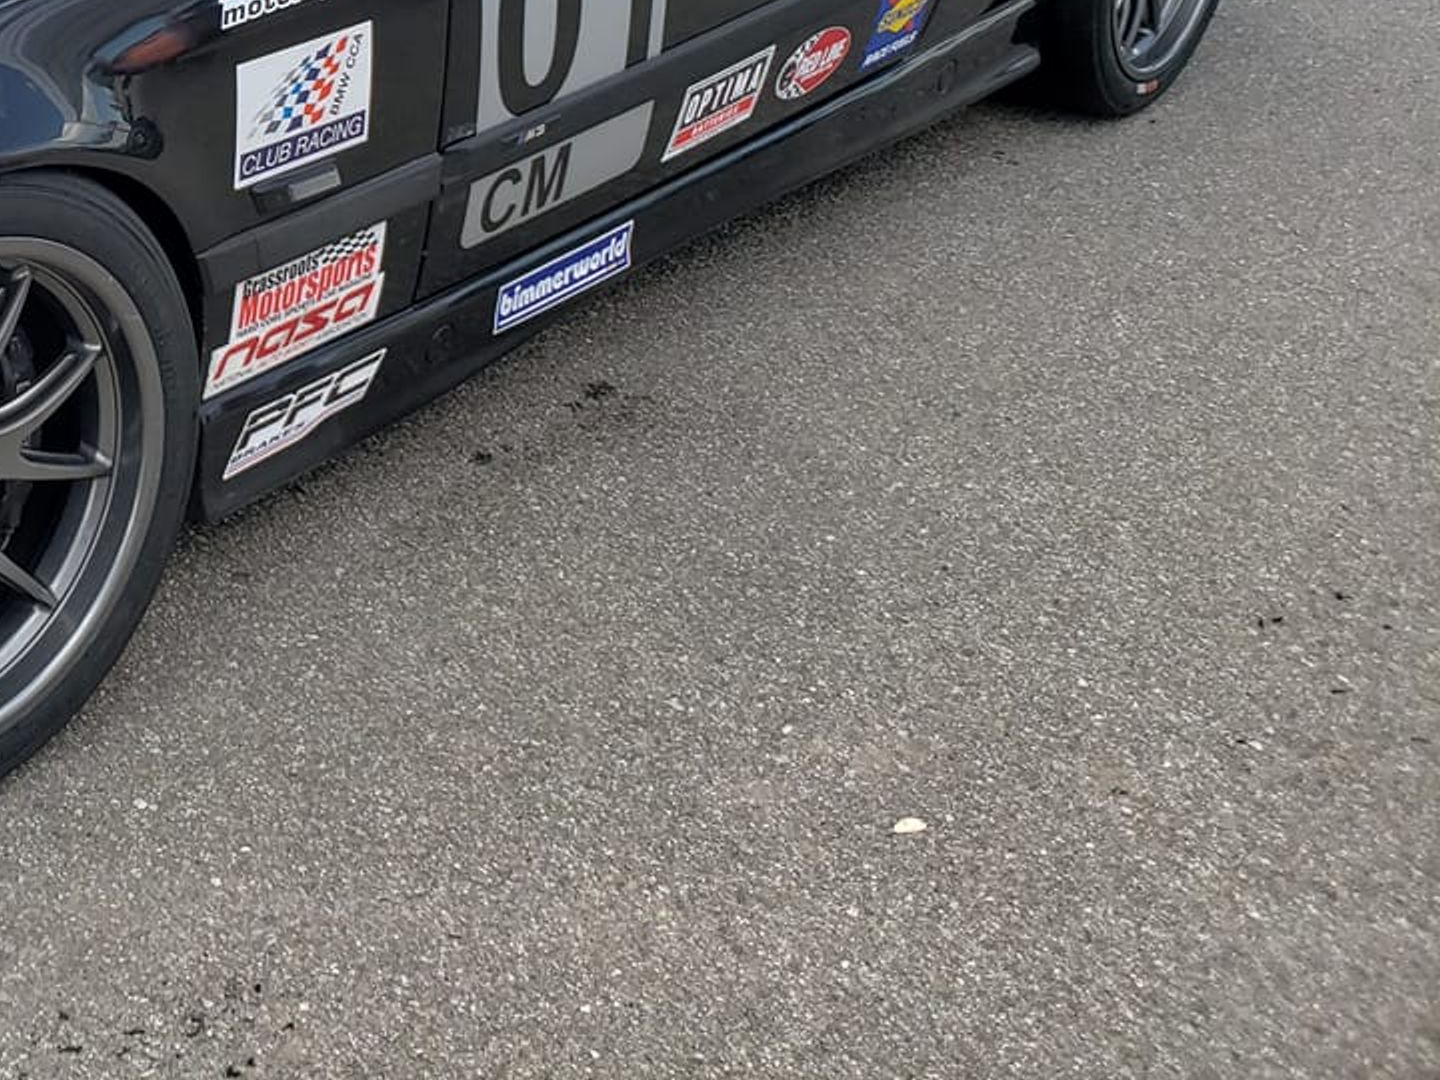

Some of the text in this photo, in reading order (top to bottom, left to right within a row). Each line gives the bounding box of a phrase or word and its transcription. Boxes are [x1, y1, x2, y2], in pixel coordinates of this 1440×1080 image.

[329, 33, 363, 115] BMW CCA
[684, 62, 763, 125] OPTIMA
[242, 116, 362, 176] CLUB RACING
[481, 142, 572, 233] CM
[238, 243, 378, 329] Motorsports
[244, 255, 320, 297] Grassroots
[499, 231, 628, 317] bimmerworld
[236, 353, 383, 452] PFC
